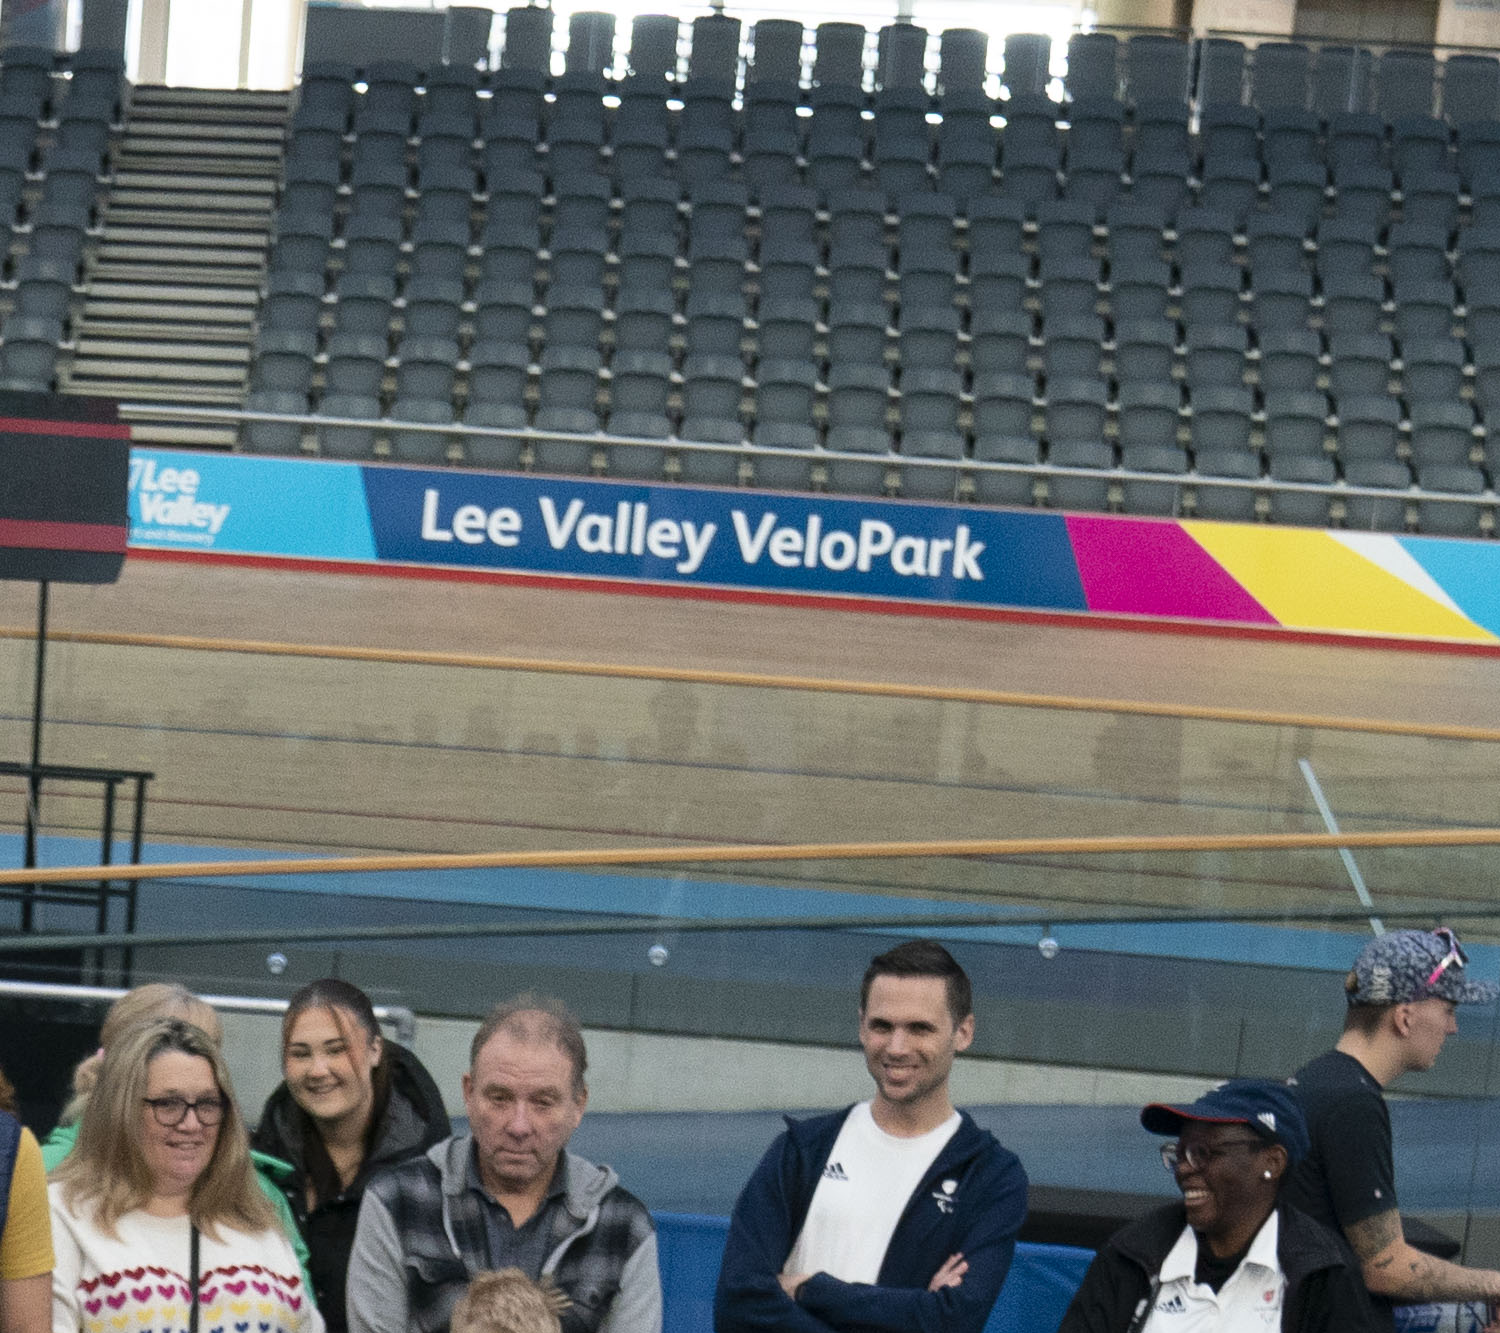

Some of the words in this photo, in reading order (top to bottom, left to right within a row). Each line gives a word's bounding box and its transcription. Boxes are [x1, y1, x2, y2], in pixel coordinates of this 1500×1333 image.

[141, 460, 199, 494] Lee
[139, 492, 231, 534] Valley
[421, 489, 521, 547] Lee
[539, 496, 716, 574] Valley
[731, 509, 986, 581] VeloPark
